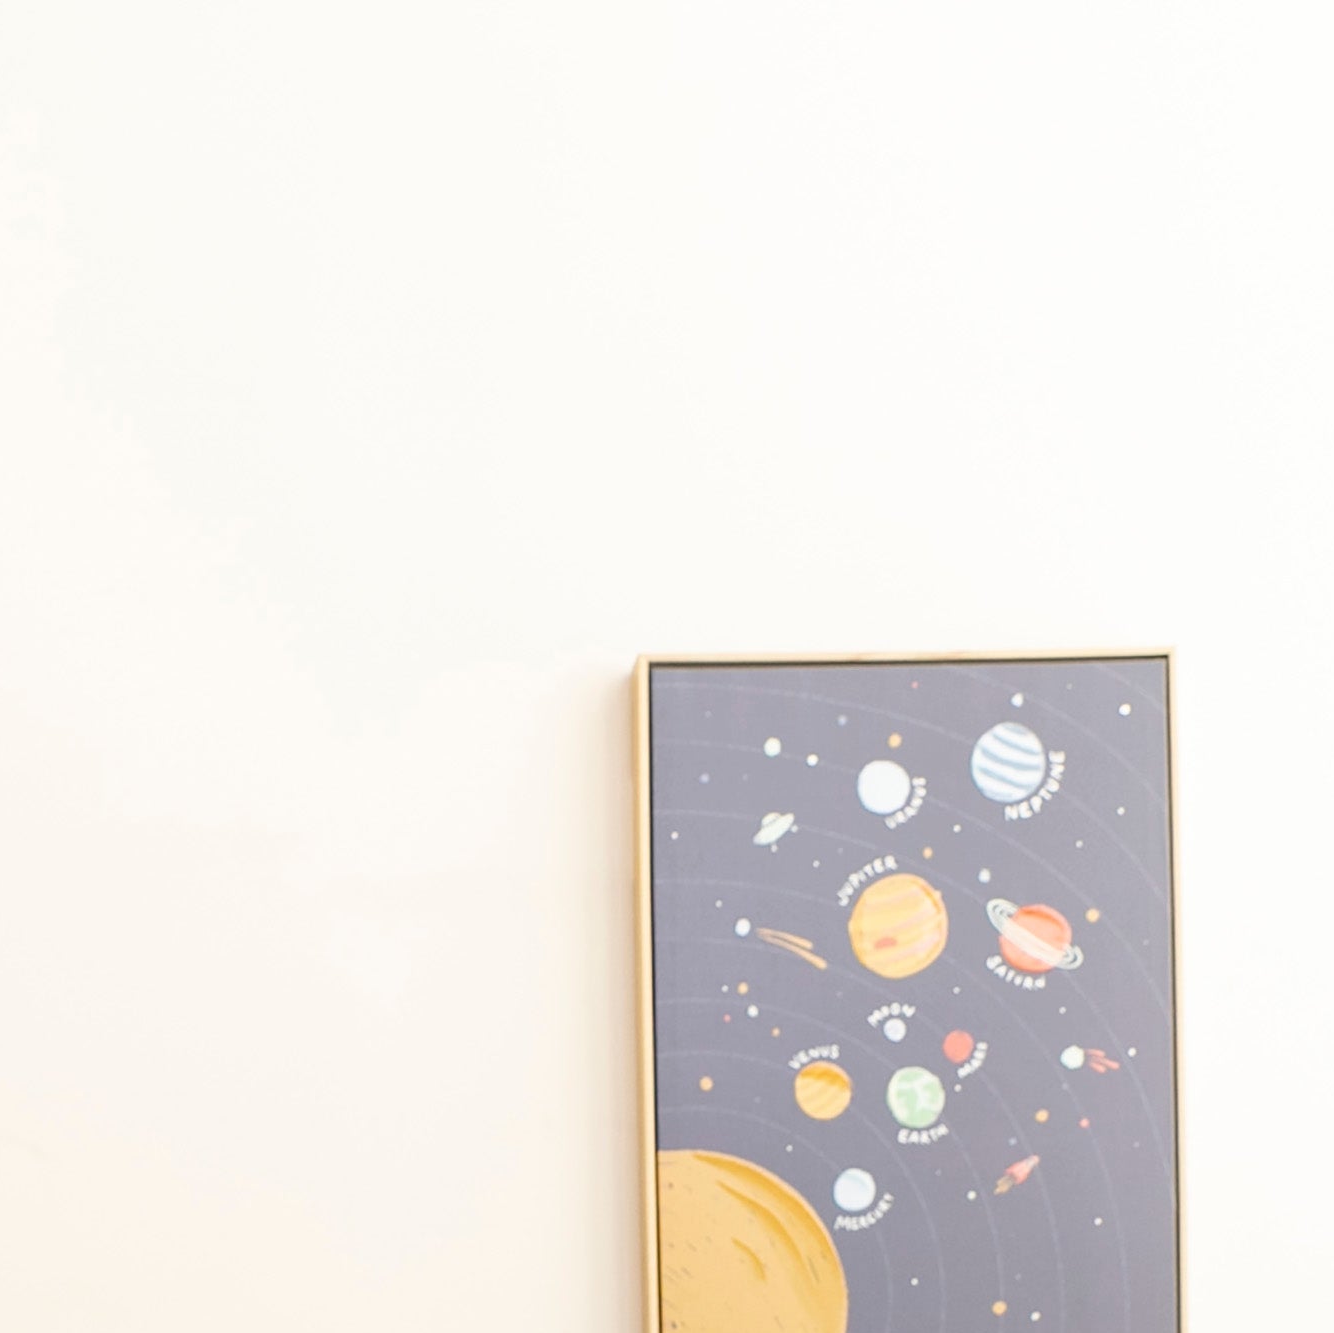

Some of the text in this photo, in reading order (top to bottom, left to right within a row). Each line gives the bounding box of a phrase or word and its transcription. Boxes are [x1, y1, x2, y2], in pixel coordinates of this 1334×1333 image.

[884, 777, 927, 830] URANUS
[1004, 750, 1066, 821] NEPTUNE
[836, 855, 898, 907] JUPITER
[985, 954, 1046, 991] SATURN
[788, 1043, 840, 1070] VENUS
[897, 1123, 949, 1144] EARTH
[834, 1192, 895, 1231] MERCURY
